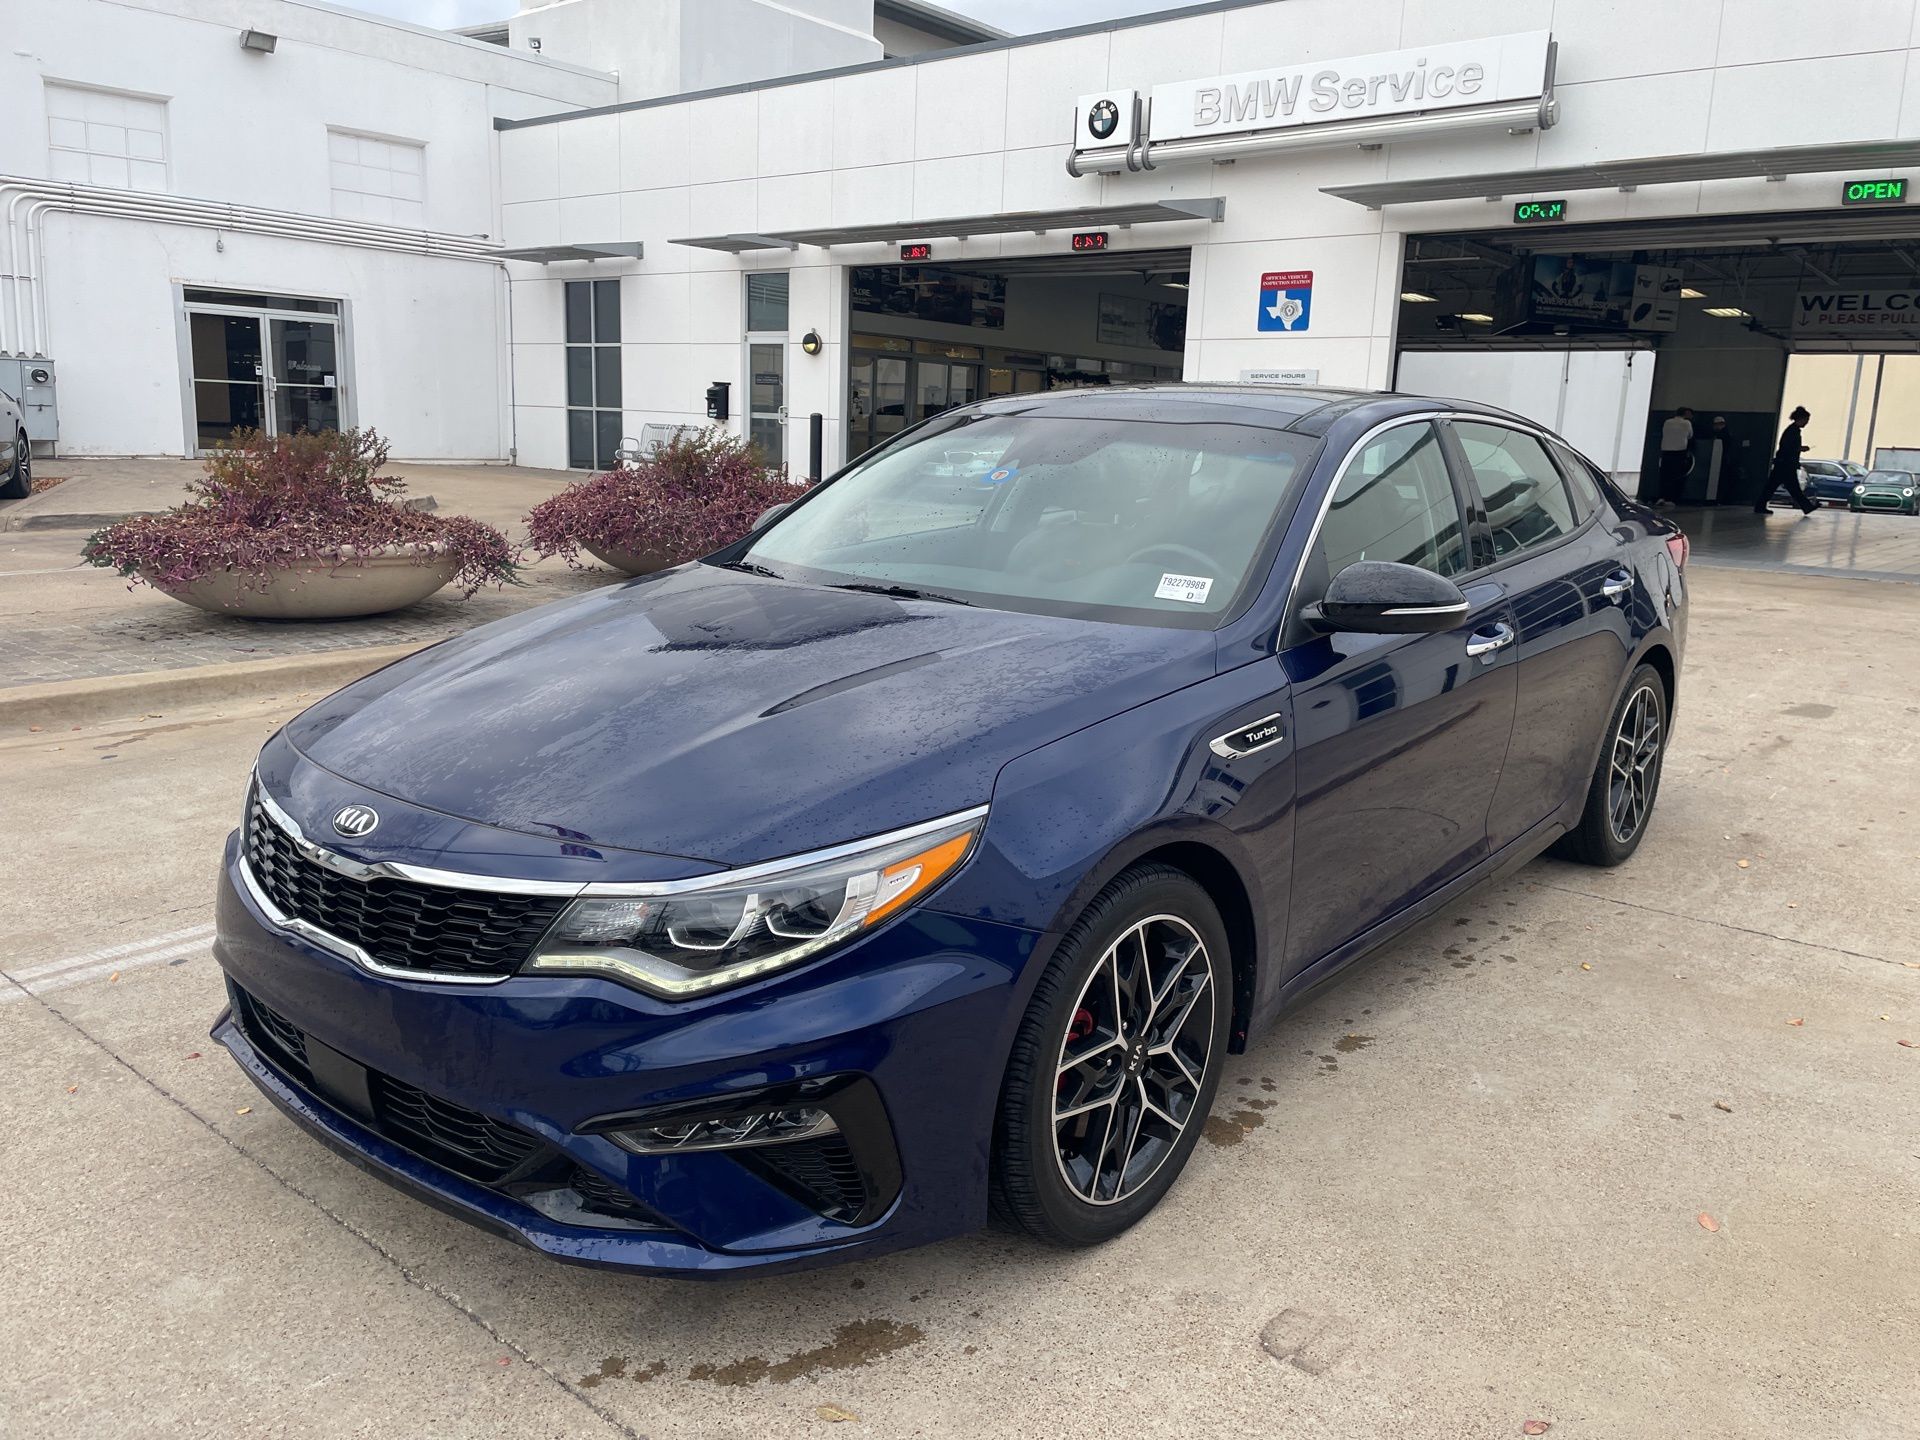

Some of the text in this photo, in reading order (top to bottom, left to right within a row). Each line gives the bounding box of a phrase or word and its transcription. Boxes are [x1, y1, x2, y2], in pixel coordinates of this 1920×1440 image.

[1193, 58, 1484, 126] BMW Service
[1848, 182, 1902, 200] OPEN
[1800, 294, 1920, 311] WELC
[1819, 313, 1919, 325] PLEASE PULL
[1246, 726, 1277, 742] Turbo
[335, 807, 370, 832] KIA
[1129, 1045, 1142, 1070] KIA
